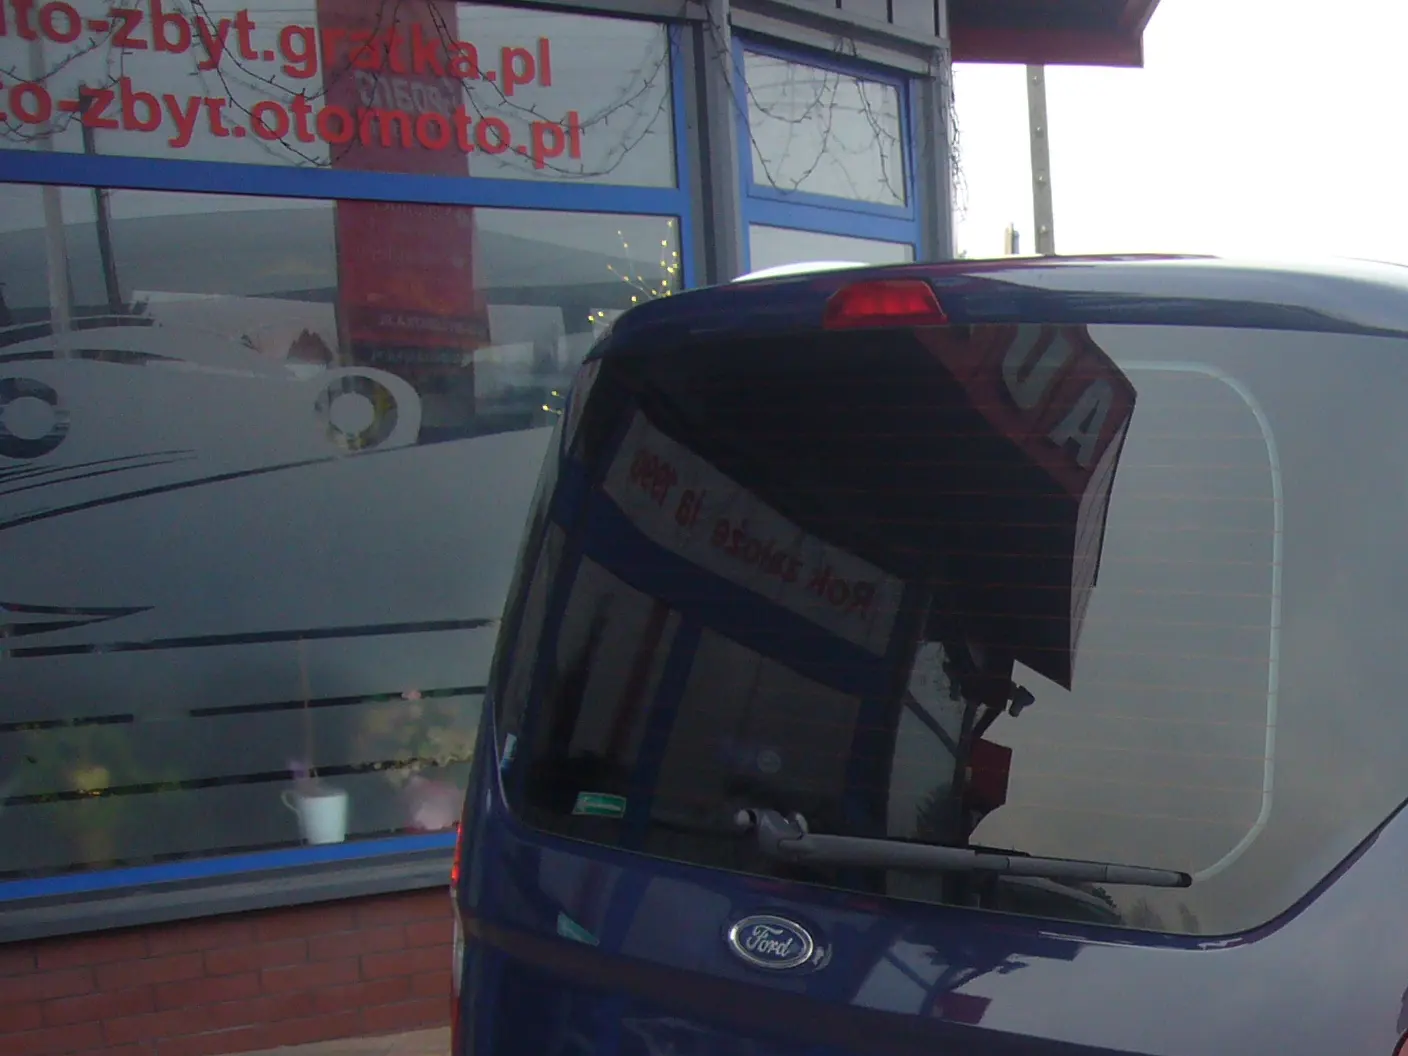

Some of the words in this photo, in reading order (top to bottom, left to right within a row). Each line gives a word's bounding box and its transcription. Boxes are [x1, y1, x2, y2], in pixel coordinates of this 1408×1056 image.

[0, 0, 551, 95] to-zbyt.gratka.pl
[0, 77, 581, 169] o-zbyt.otomoto.pl
[746, 925, 793, 957] Ford
